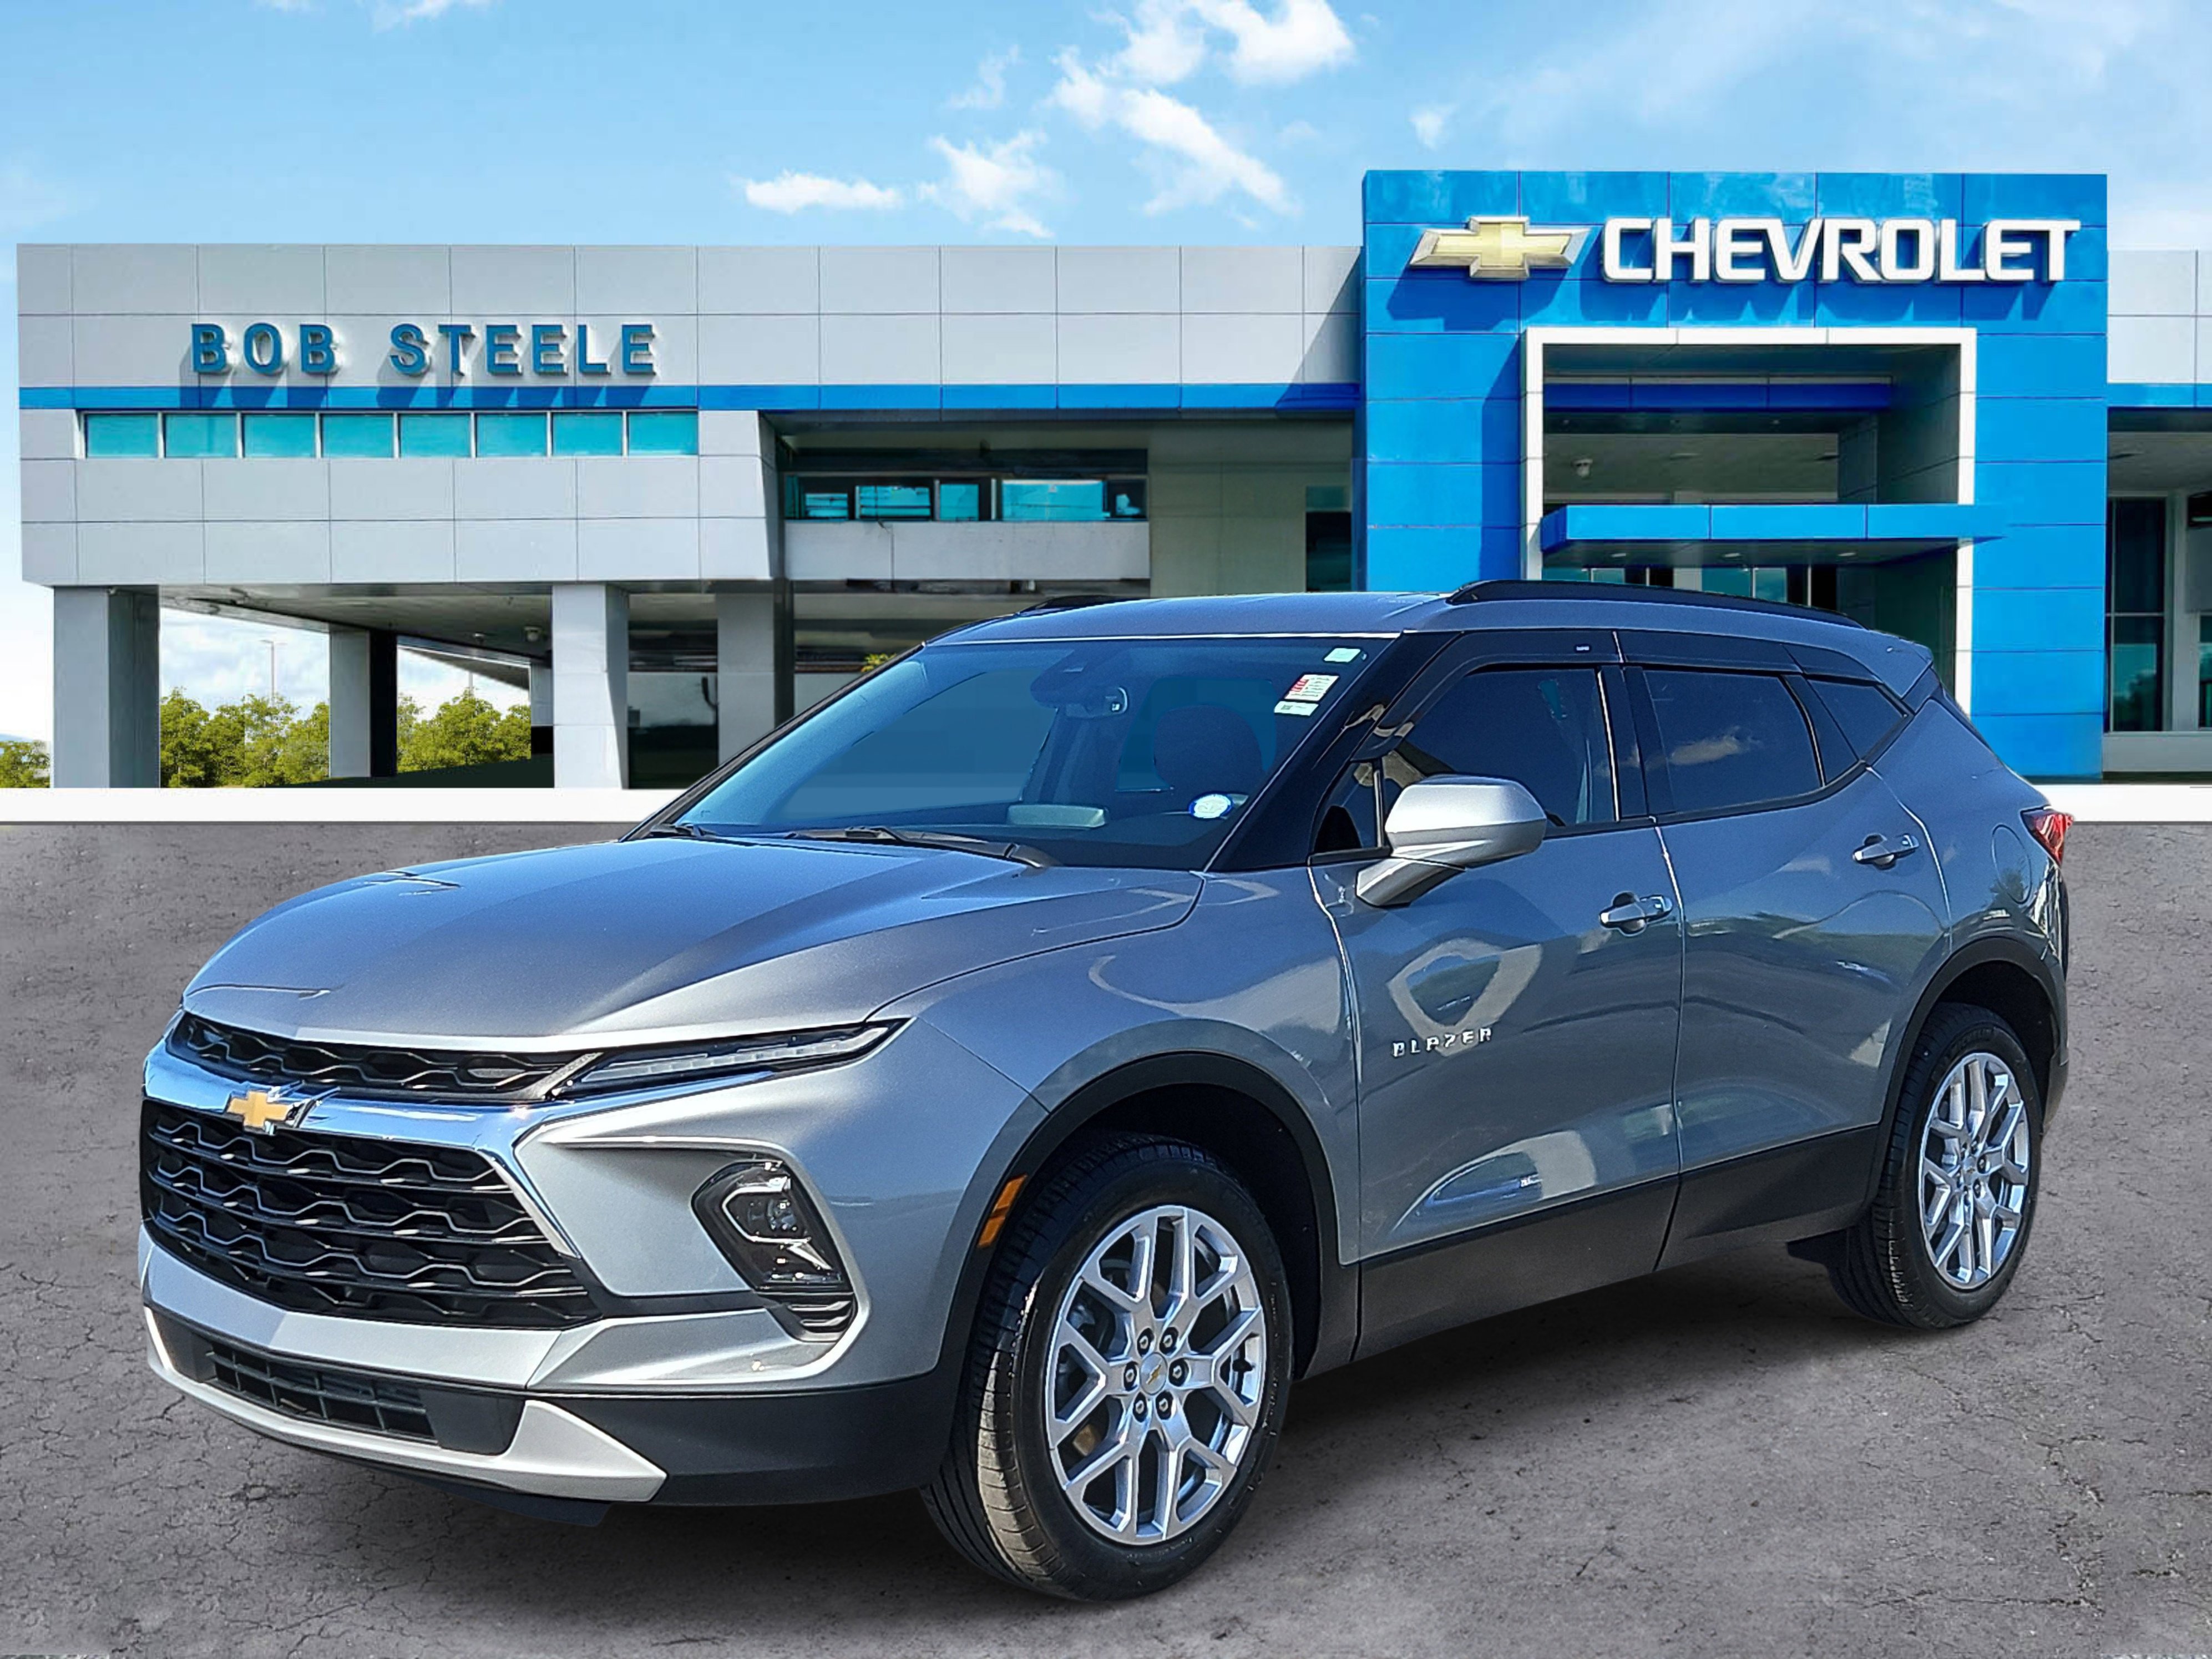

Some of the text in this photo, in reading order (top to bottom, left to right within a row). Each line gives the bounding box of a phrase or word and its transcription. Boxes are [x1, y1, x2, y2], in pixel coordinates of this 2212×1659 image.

[1600, 217, 2082, 284] CHEVROLET
[191, 323, 657, 376] BOB STEELE
[1393, 1028, 1491, 1057] BLAZER
